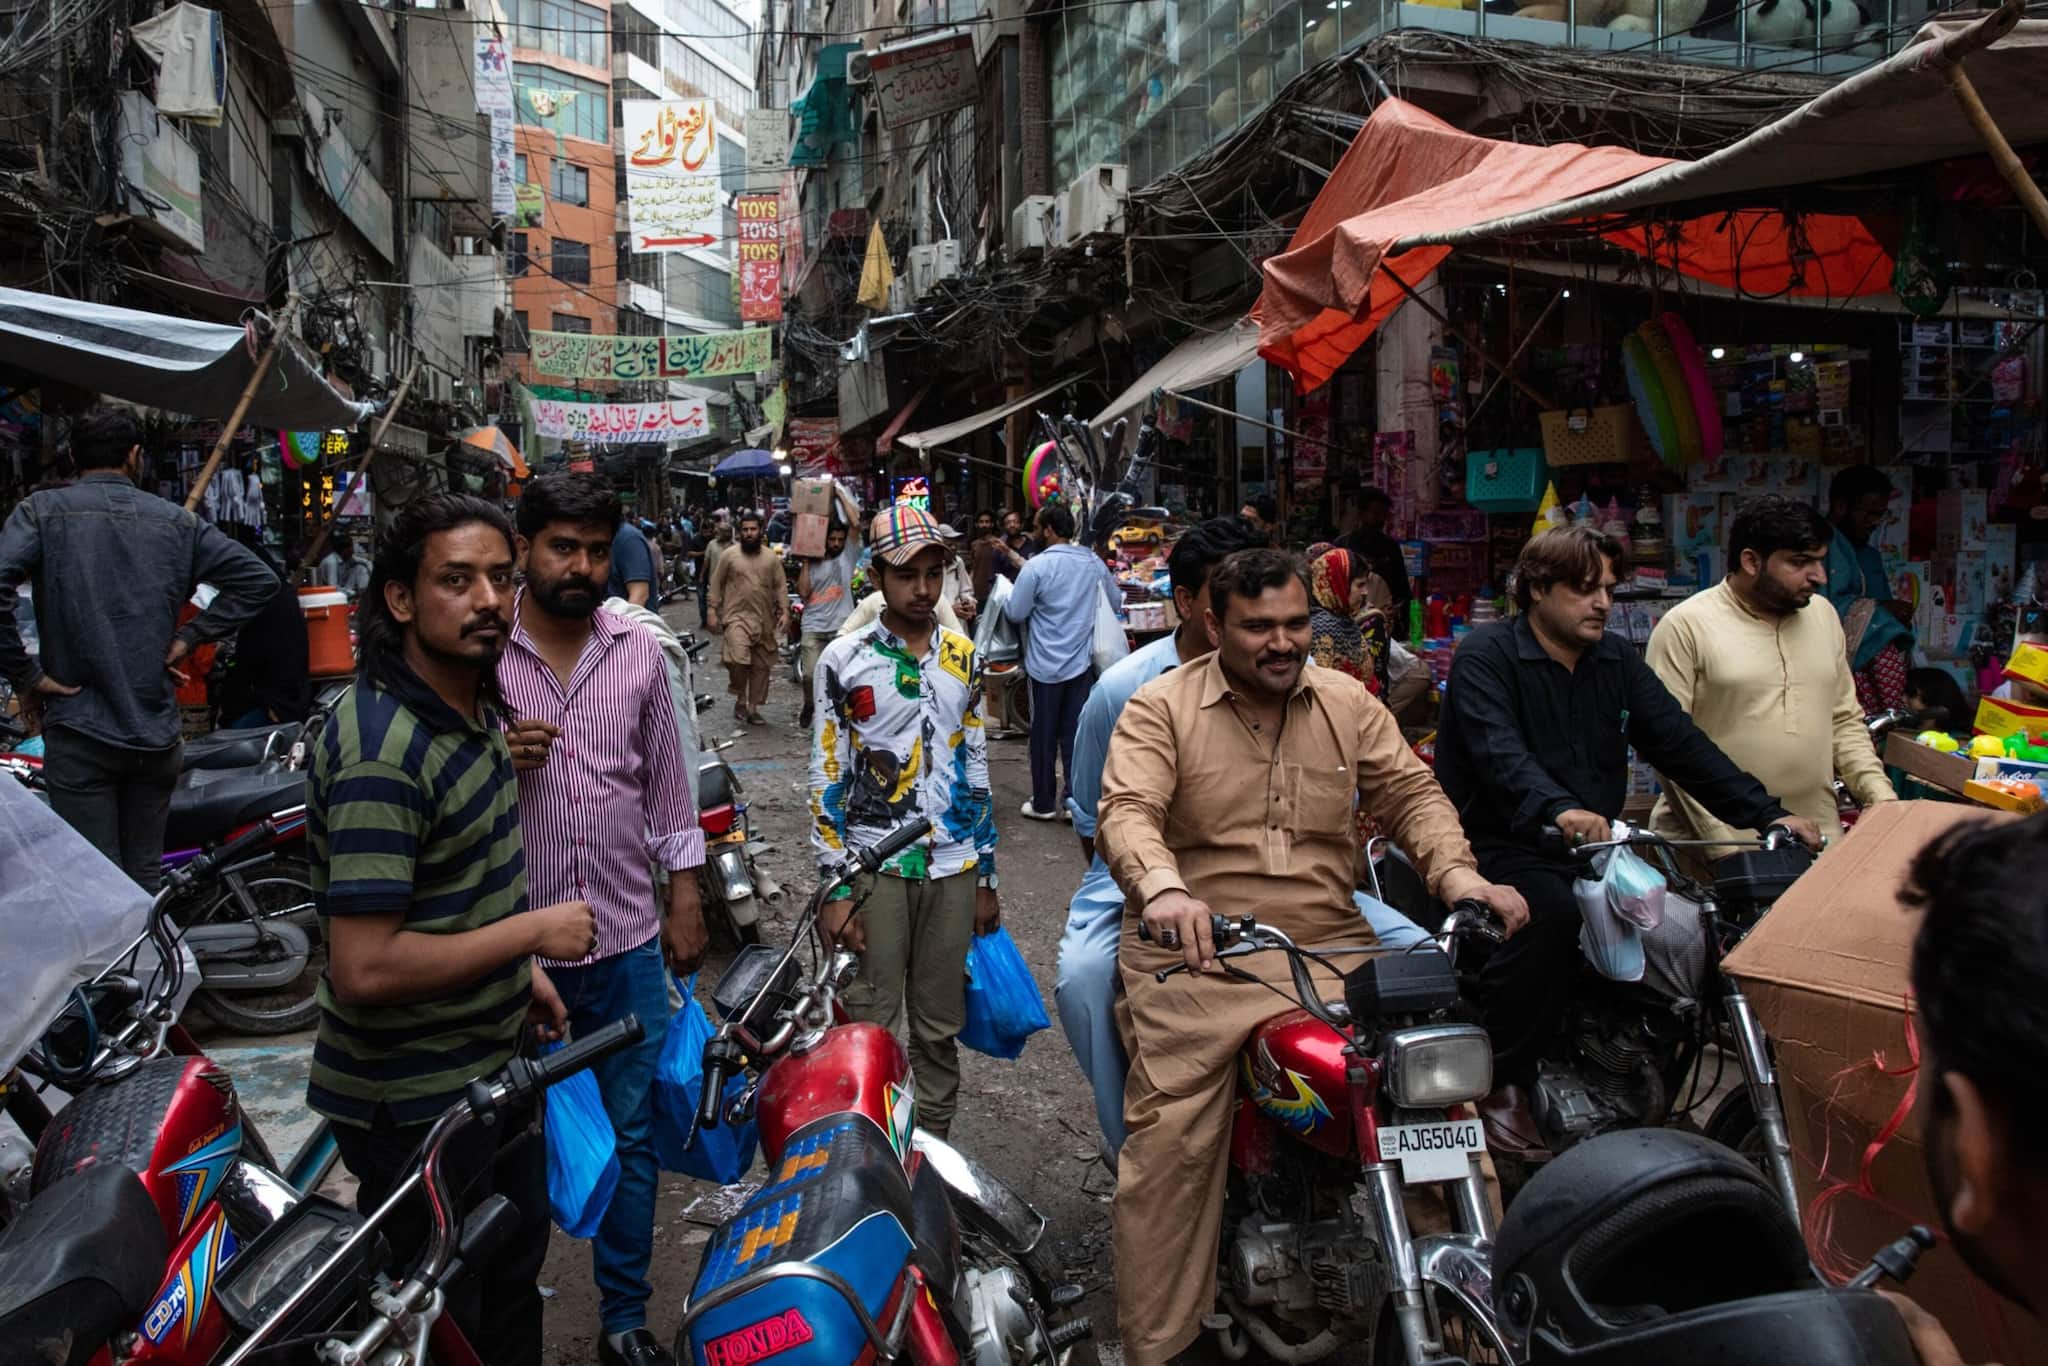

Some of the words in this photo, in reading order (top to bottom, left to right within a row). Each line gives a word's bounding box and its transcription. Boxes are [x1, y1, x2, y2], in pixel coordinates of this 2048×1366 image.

[682, 101, 716, 172] الفتح
[739, 201, 778, 219] TOYS
[740, 222, 778, 240] TOYS
[741, 244, 779, 262] TOYS
[1399, 1126, 1478, 1152] AJG5040
[707, 1308, 812, 1366] HONDA
